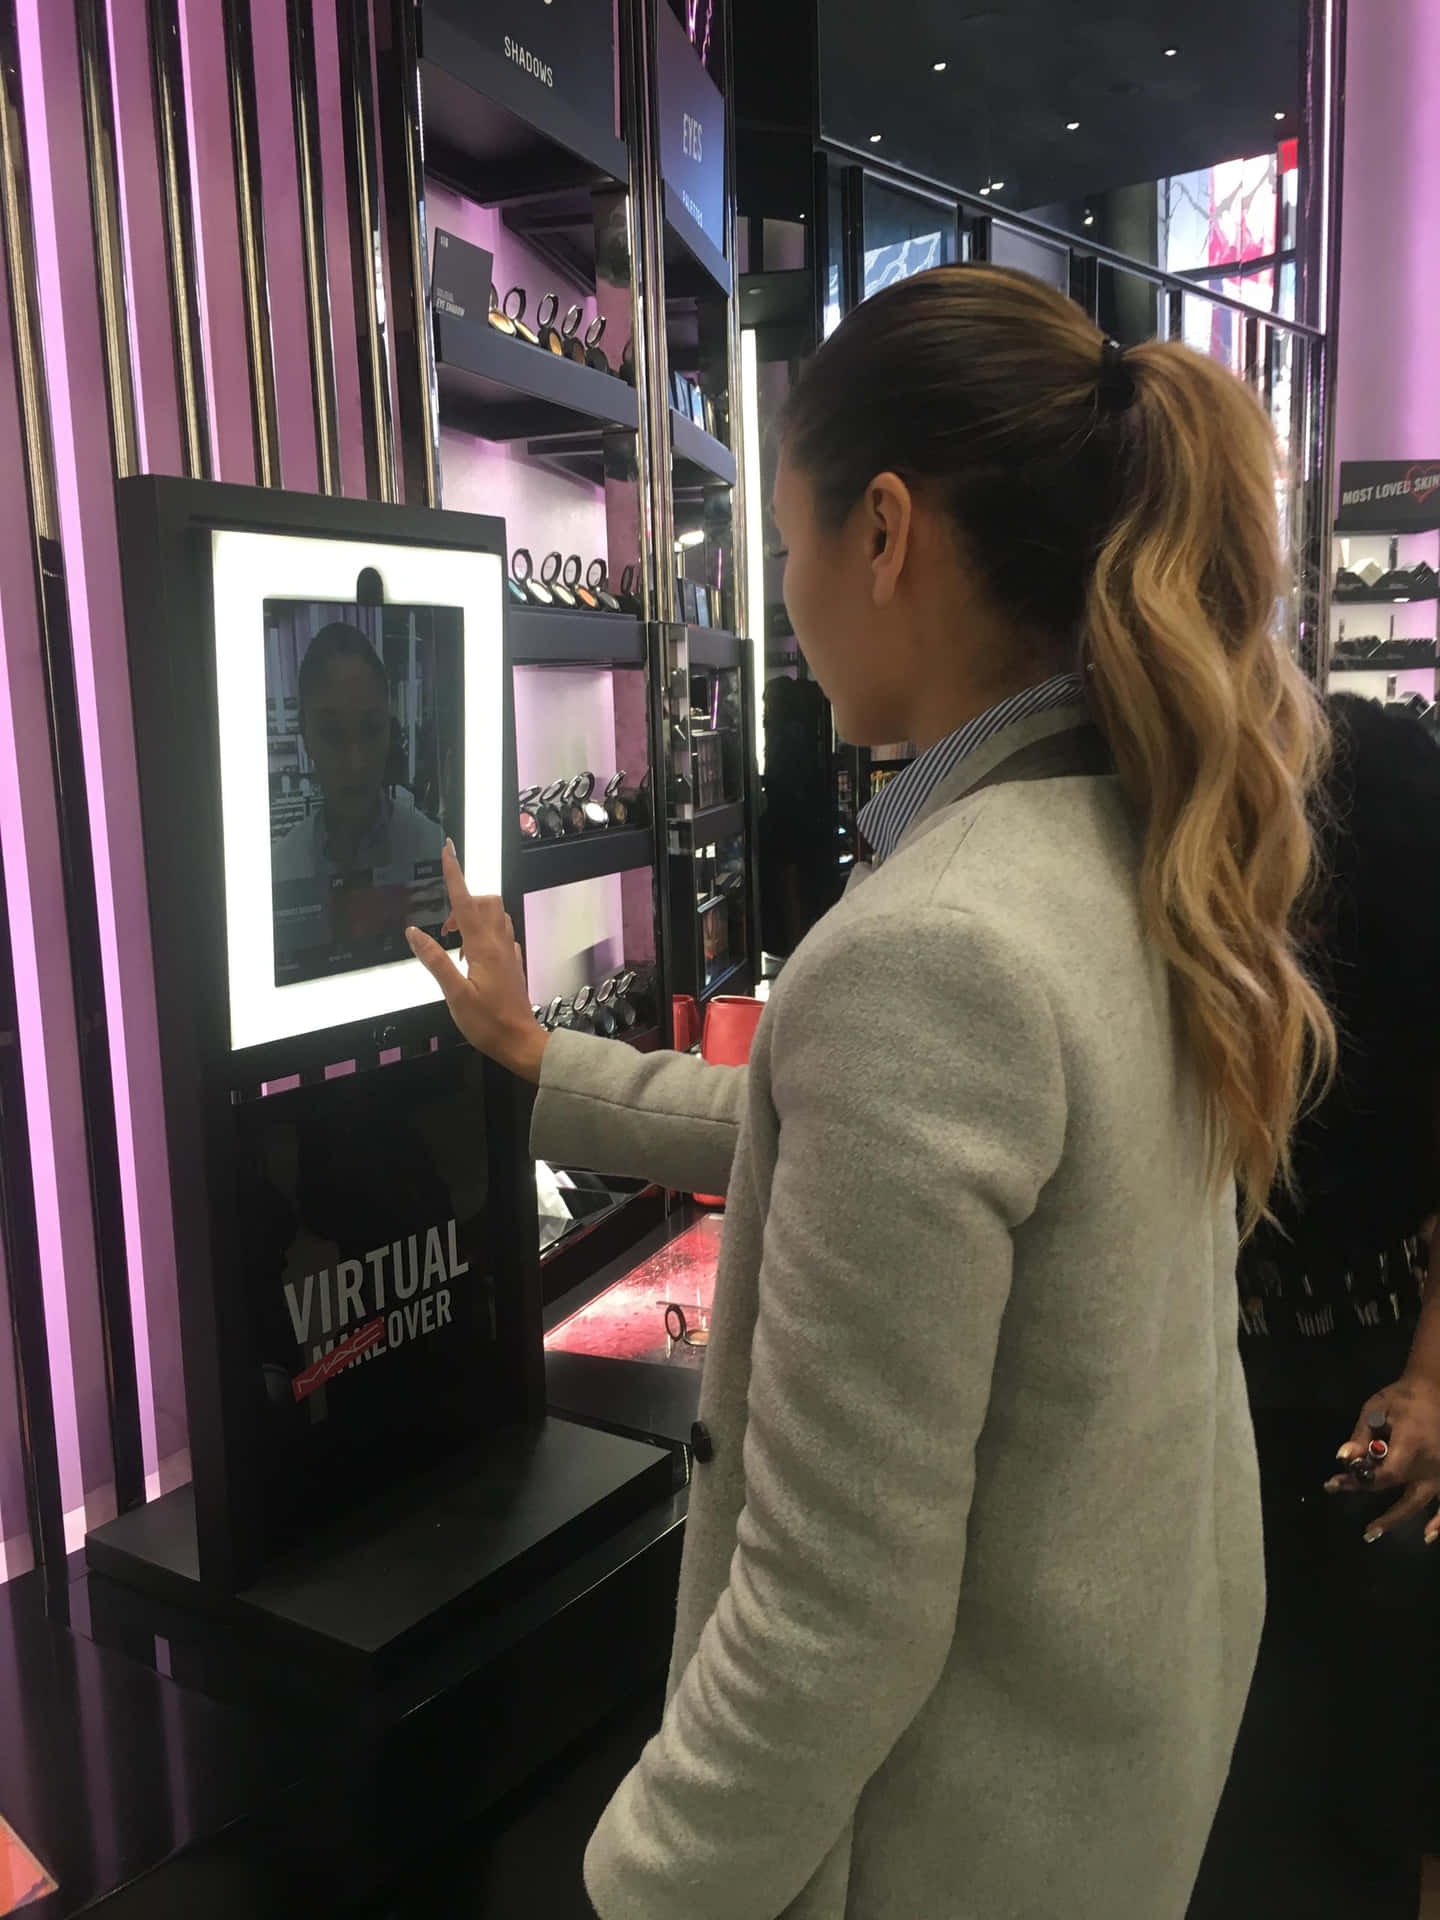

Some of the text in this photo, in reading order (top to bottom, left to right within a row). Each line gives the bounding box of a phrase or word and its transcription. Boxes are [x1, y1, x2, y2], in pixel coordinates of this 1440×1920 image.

[504, 36, 553, 87] SHADOWS
[682, 112, 703, 162] EYES
[1342, 486, 1374, 505] MOST
[1376, 480, 1410, 499] LOVED
[284, 1219, 468, 1345] VIRTUAL
[312, 1289, 452, 1376] OVER
